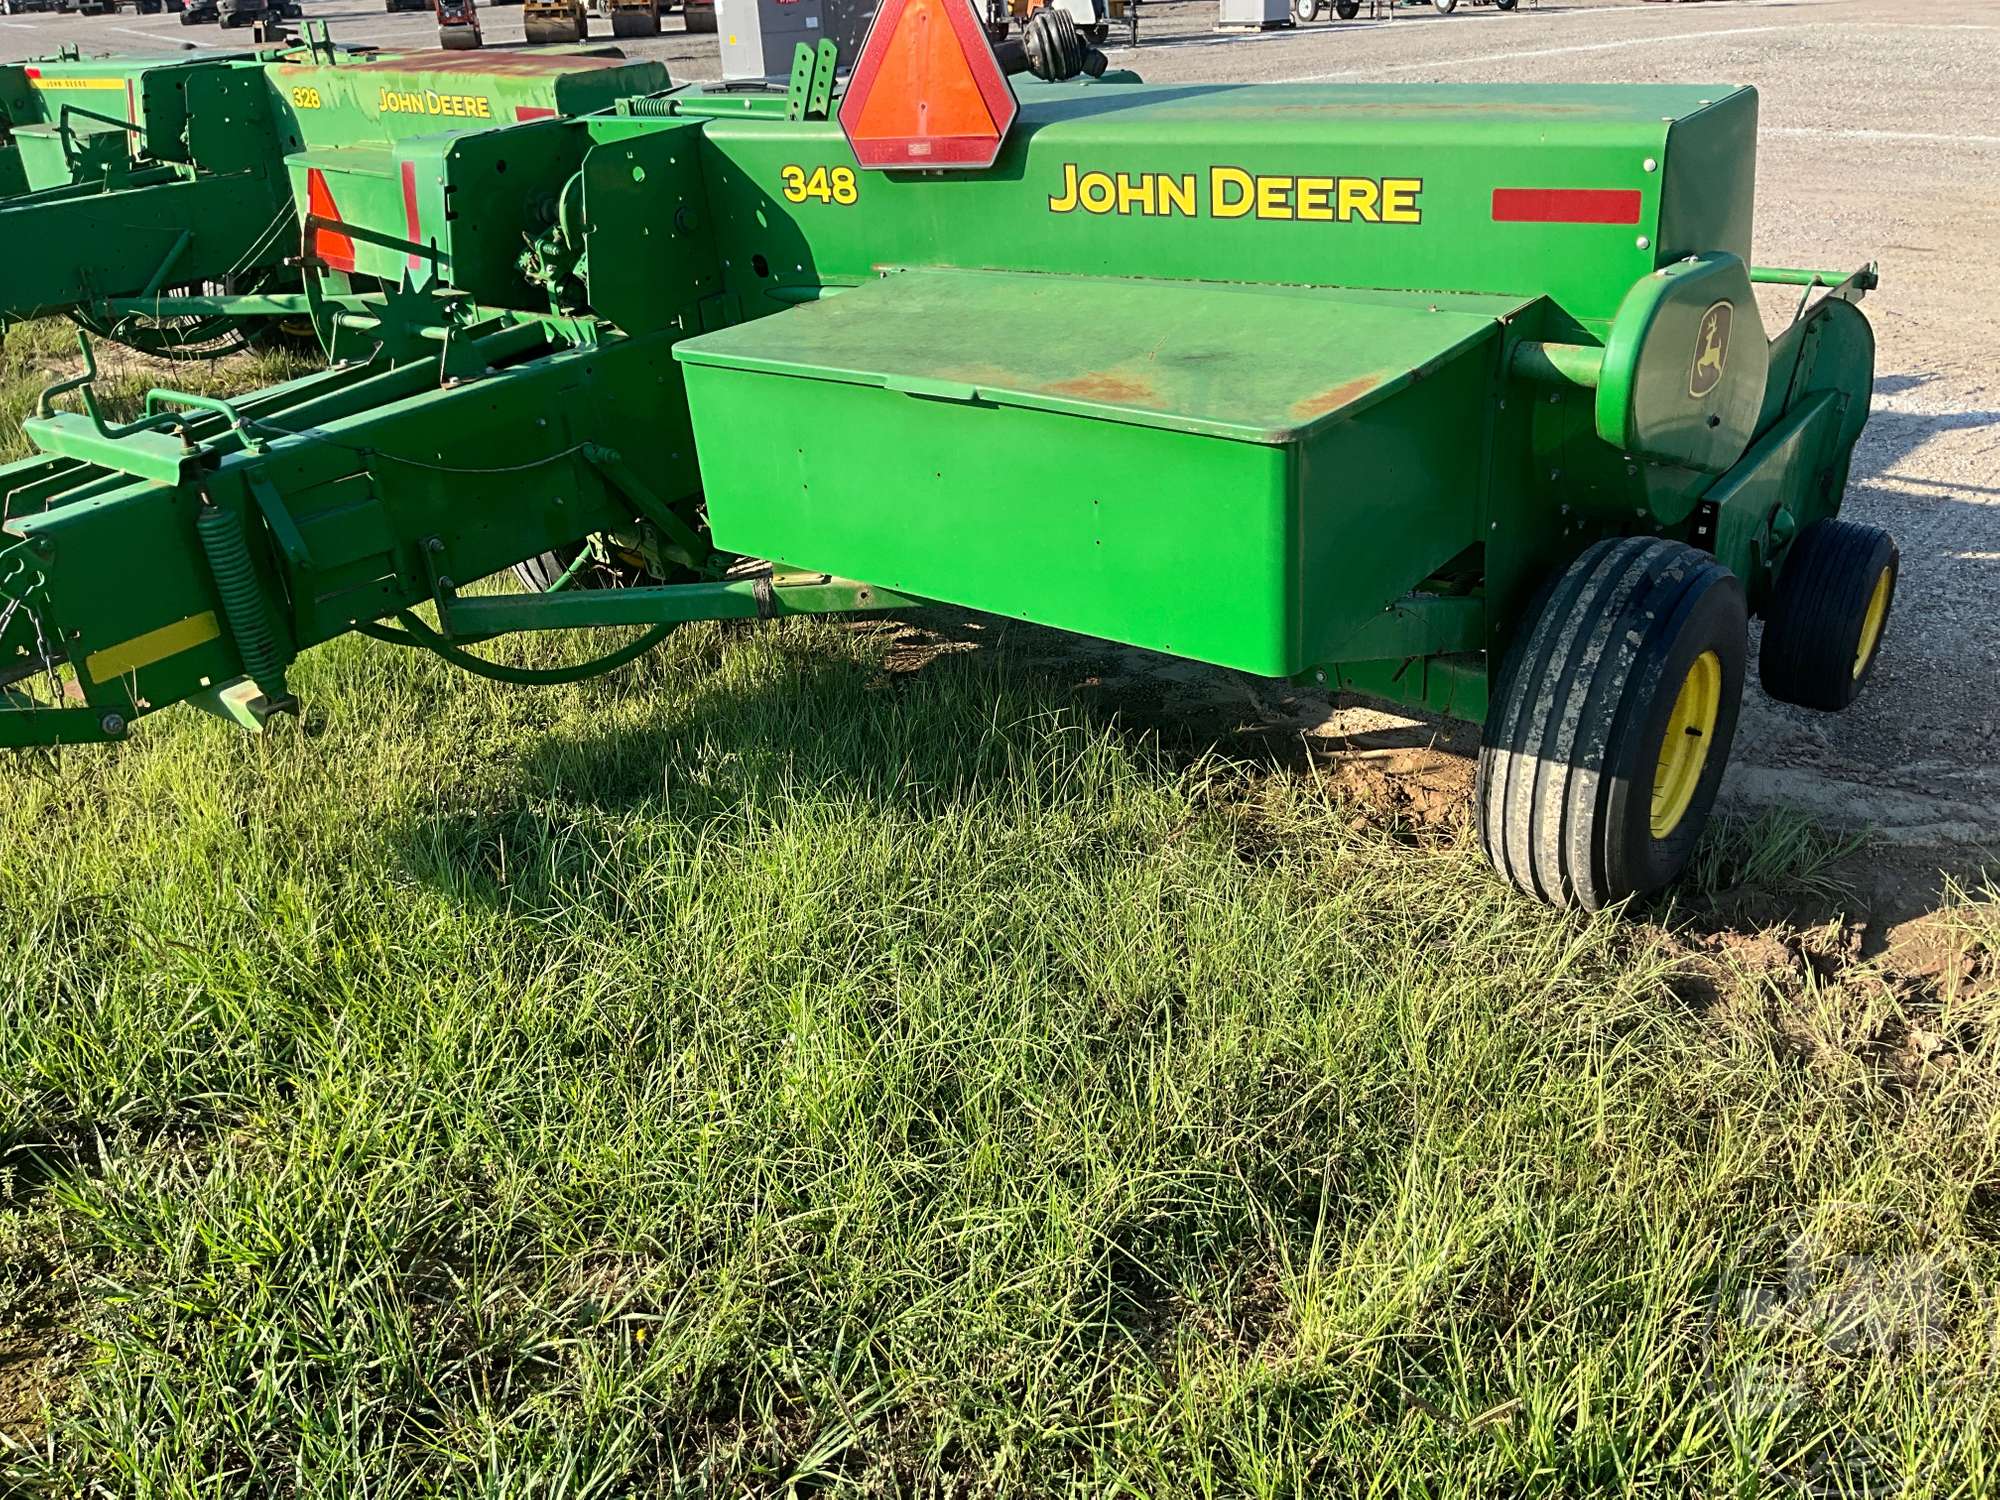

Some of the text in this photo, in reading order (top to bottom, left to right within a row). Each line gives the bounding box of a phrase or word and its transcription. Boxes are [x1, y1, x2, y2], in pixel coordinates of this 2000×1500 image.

[293, 87, 321, 110] 328
[379, 88, 491, 118] JOHN DEERE
[781, 164, 858, 206] 348
[1048, 163, 1423, 225] JOHN DEERE
